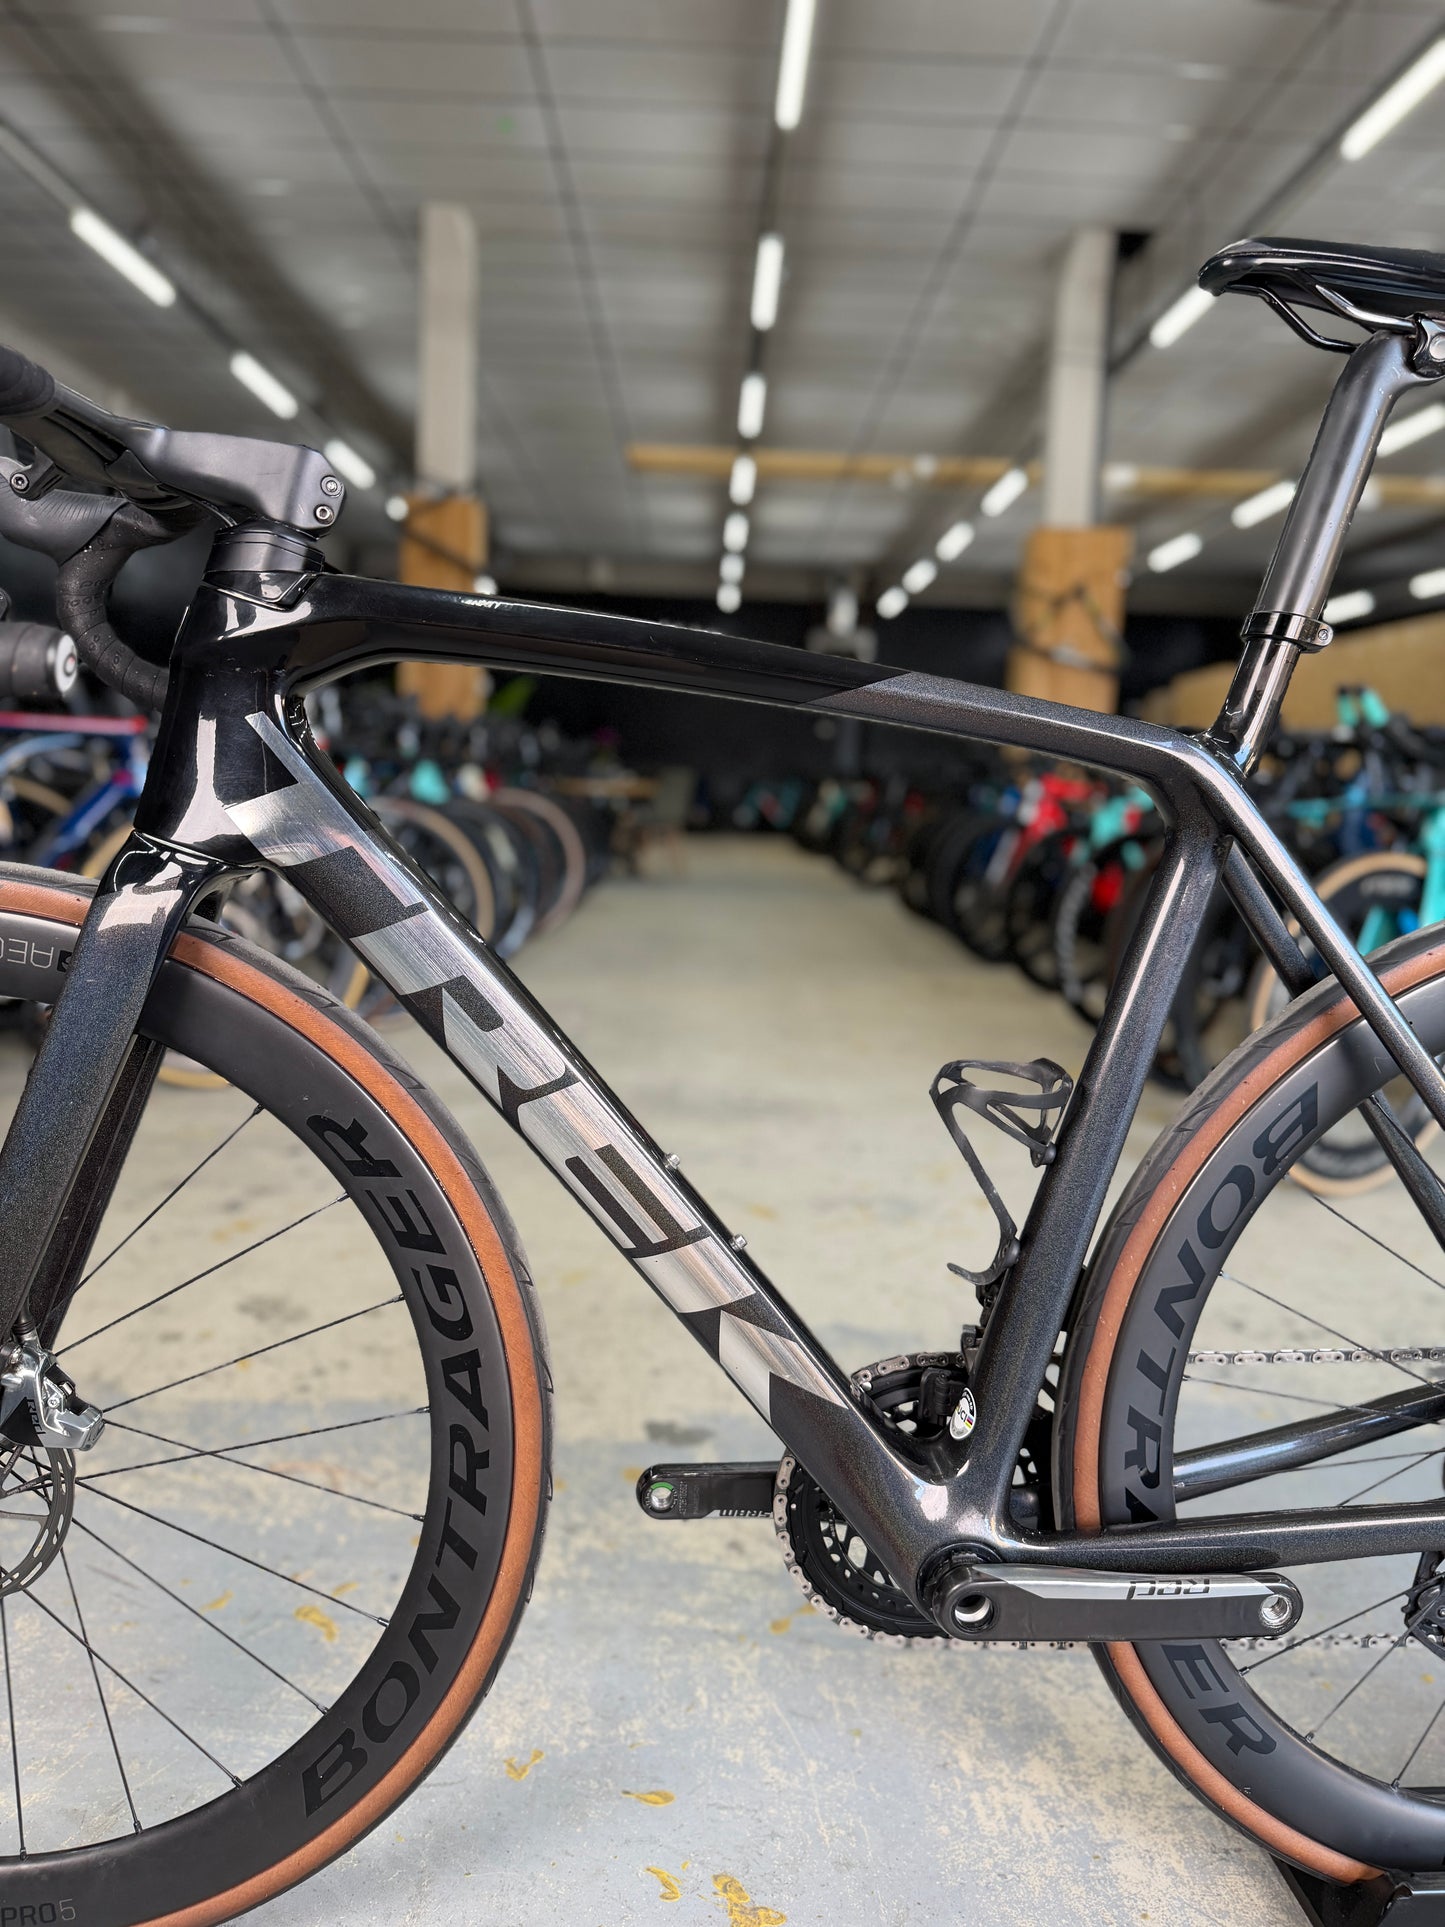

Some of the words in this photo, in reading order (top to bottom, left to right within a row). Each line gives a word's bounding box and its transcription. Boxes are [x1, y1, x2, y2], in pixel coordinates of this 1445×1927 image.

[0, 936, 54, 968] AE
[224, 711, 848, 1424] TREK
[301, 1114, 491, 1817] BONTRAGER
